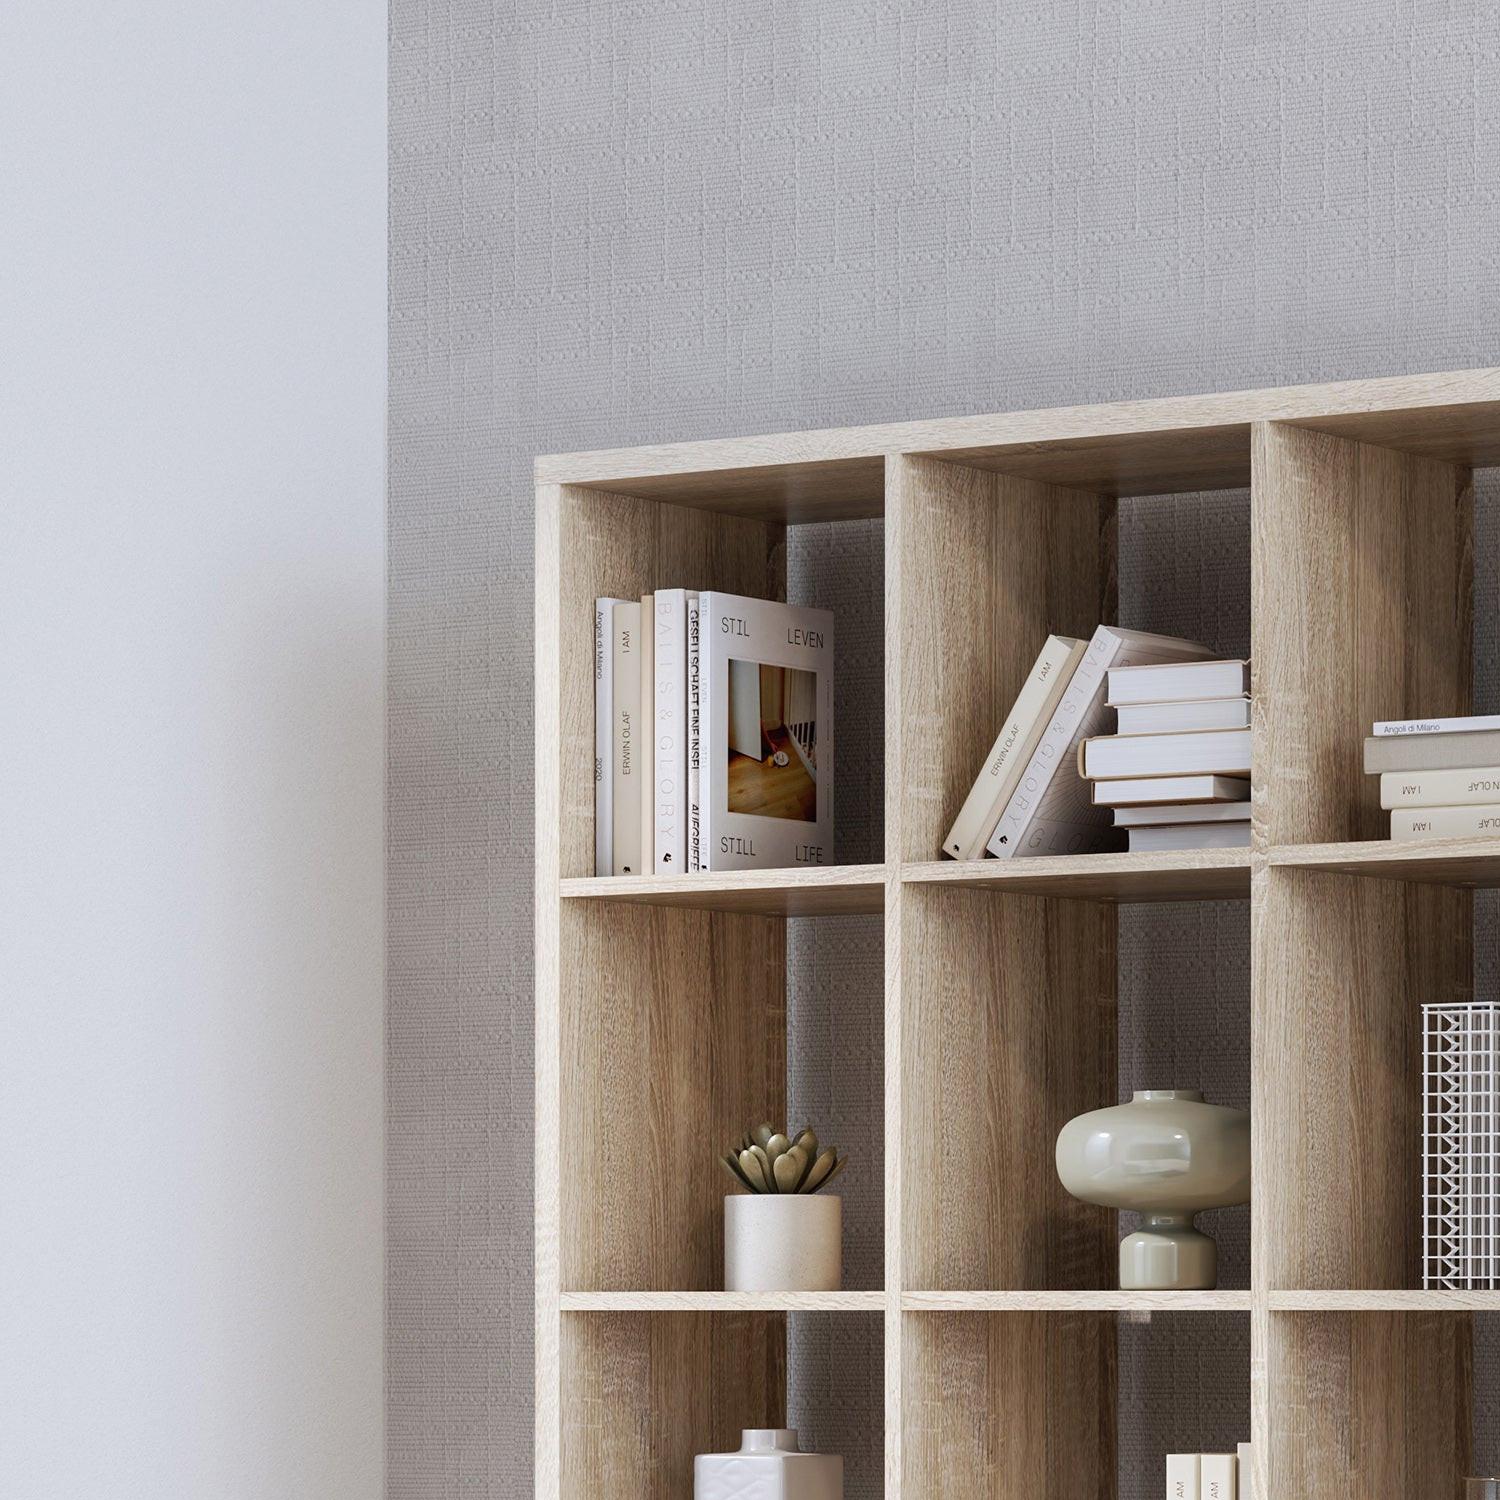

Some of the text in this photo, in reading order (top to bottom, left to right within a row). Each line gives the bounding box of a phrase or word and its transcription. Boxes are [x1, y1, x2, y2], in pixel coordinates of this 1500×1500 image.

[622, 630, 630, 648] AM
[721, 616, 824, 649] STIL LEVEN
[622, 711, 631, 739] OLAF
[990, 745, 1010, 777] ERWIN
[1005, 724, 1021, 748] OLAF
[1041, 661, 1053, 678] AM
[1383, 724, 1407, 735] Angoli
[1408, 723, 1415, 733] di
[1416, 723, 1441, 732] Milano
[622, 741, 631, 776] ERWIN
[1402, 786, 1417, 795] AM
[1468, 781, 1491, 792] OLAF
[1412, 823, 1428, 832] AM
[720, 836, 823, 864] STILL LIFE
[1176, 1481, 1184, 1499] AM
[1210, 1481, 1219, 1499] AM
